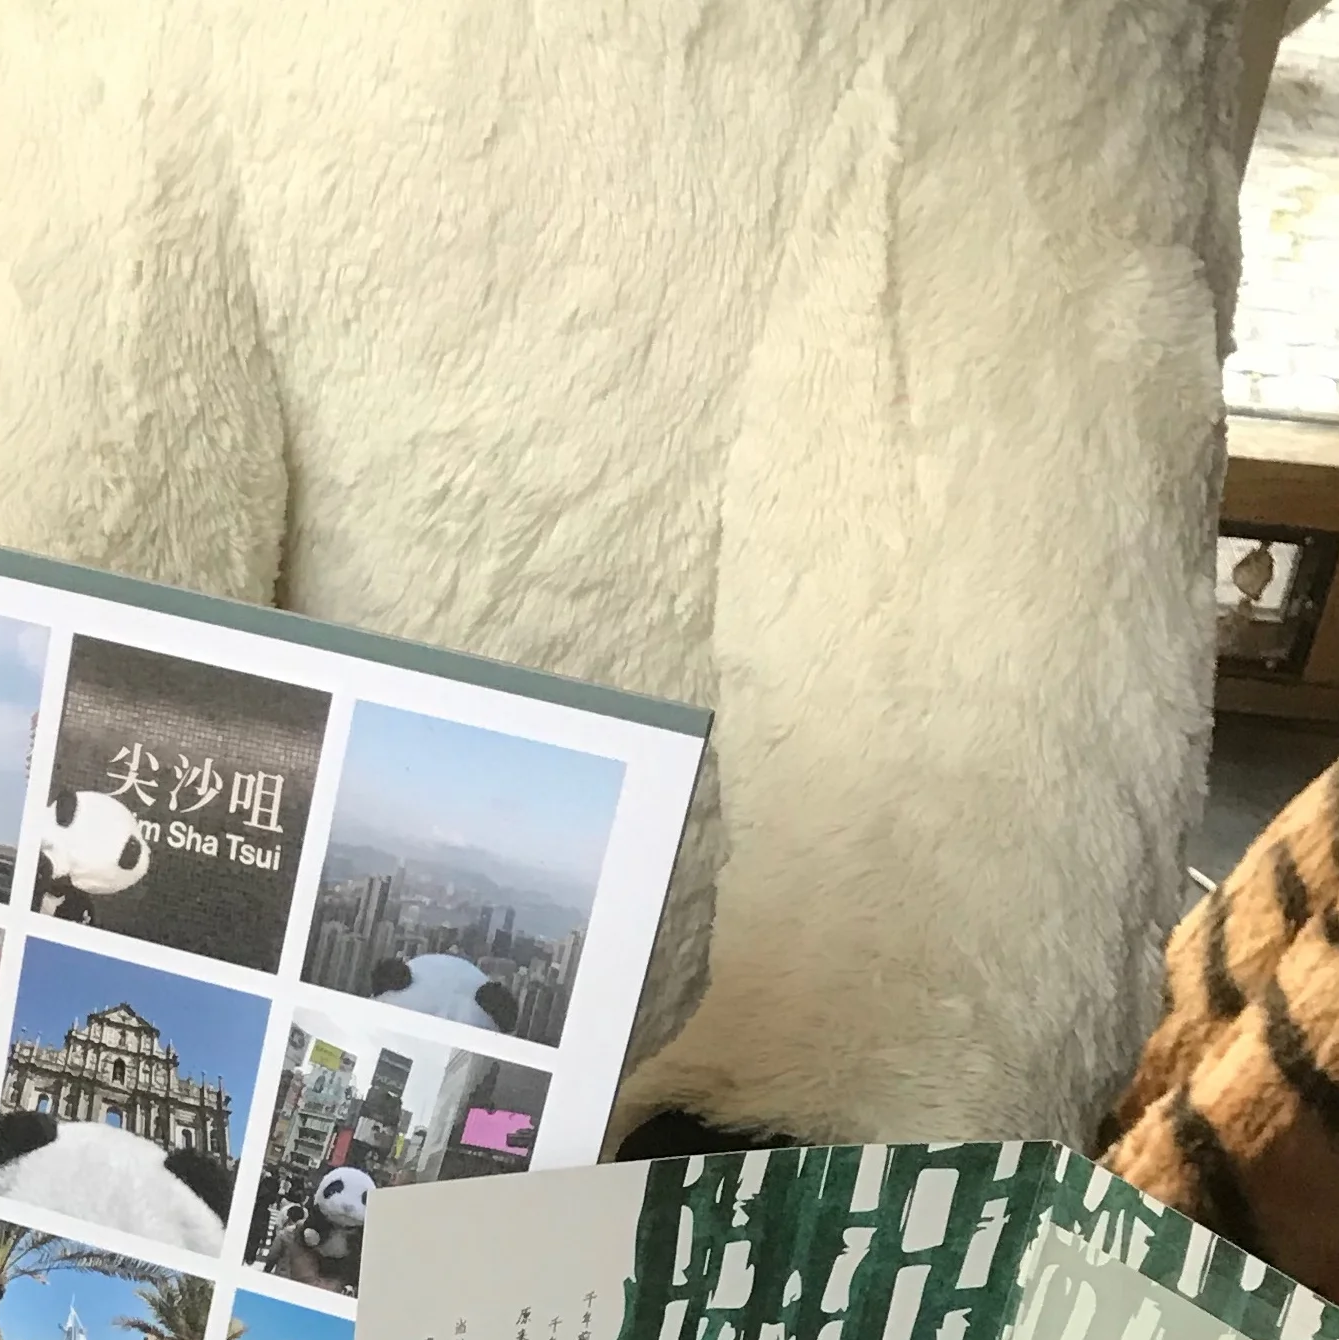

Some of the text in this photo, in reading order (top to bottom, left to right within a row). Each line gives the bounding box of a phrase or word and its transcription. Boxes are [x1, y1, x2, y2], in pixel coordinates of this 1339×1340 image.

[106, 742, 285, 834] 尖沙咀
[167, 821, 219, 857] Sha
[226, 833, 282, 871] Tsui
